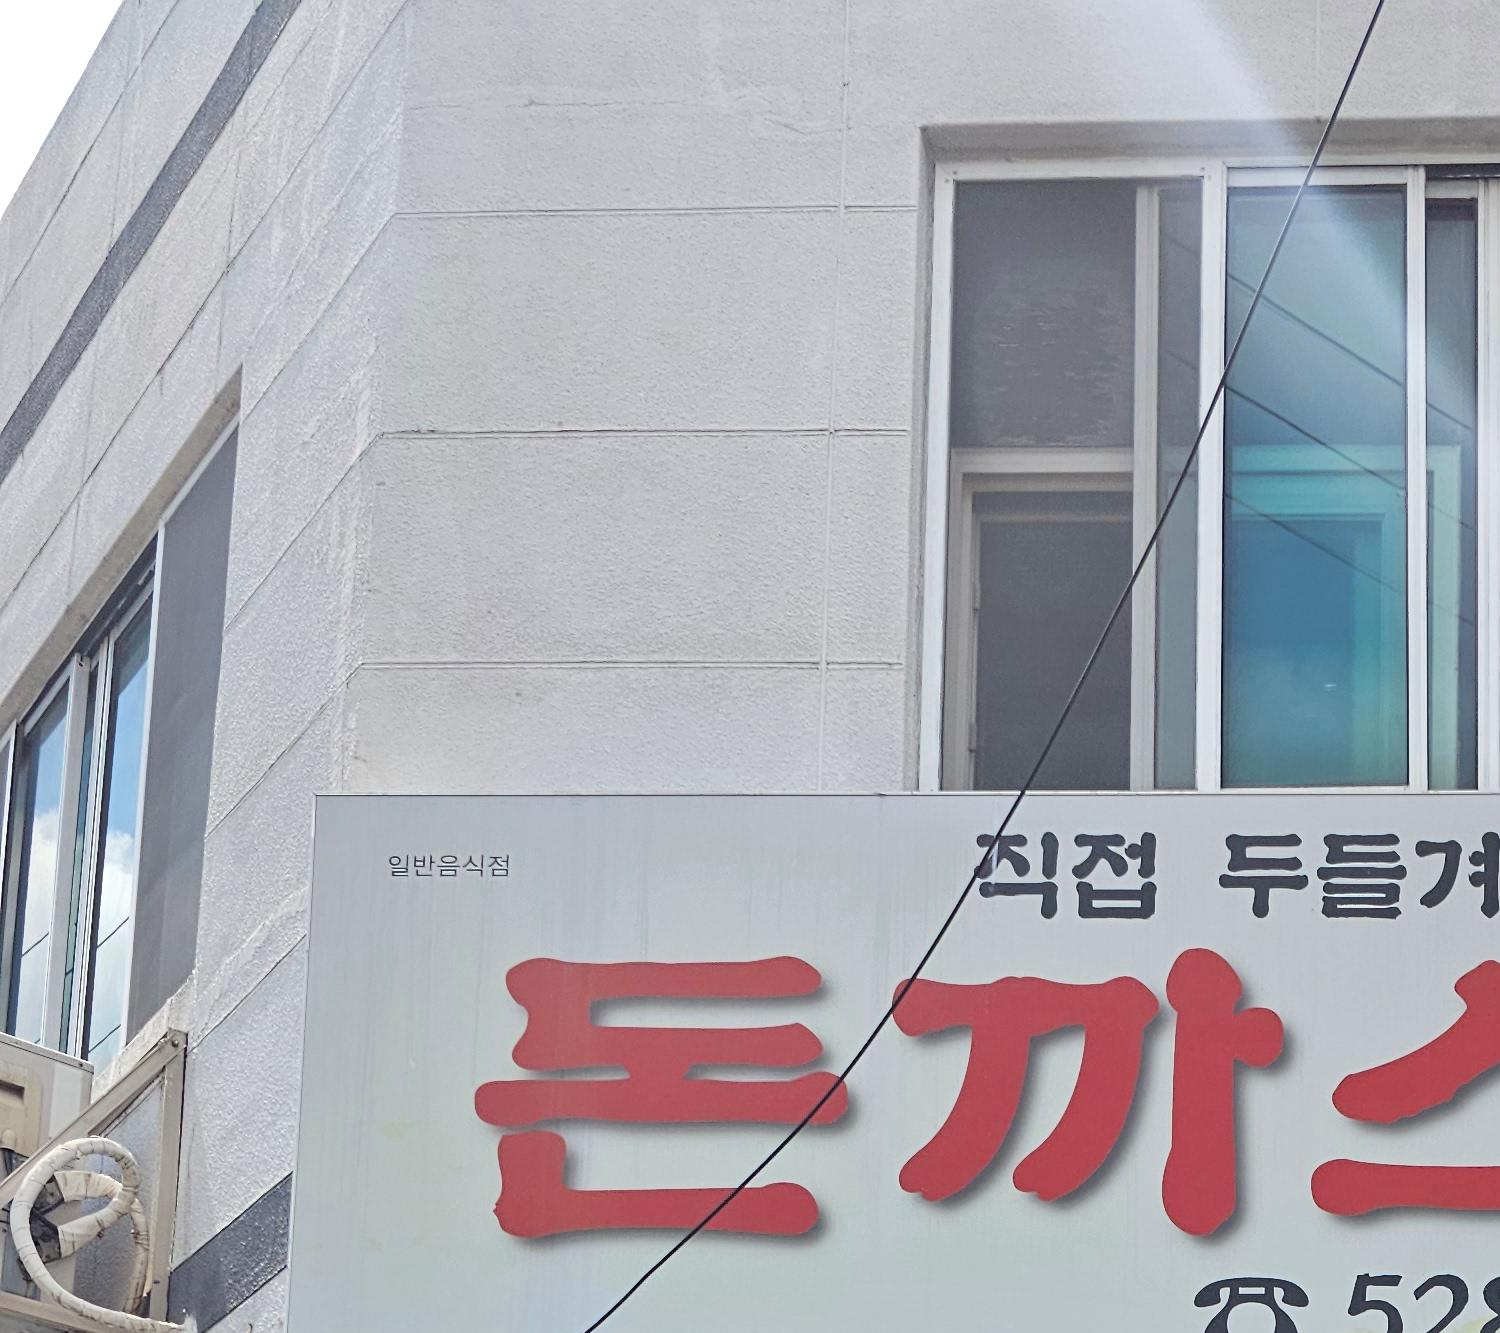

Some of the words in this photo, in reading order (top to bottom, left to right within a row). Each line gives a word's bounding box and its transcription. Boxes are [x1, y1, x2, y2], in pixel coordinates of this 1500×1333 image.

[388, 853, 511, 878] 일반음식점
[977, 832, 1157, 919] 직접
[1219, 831, 1500, 919] 두들겨
